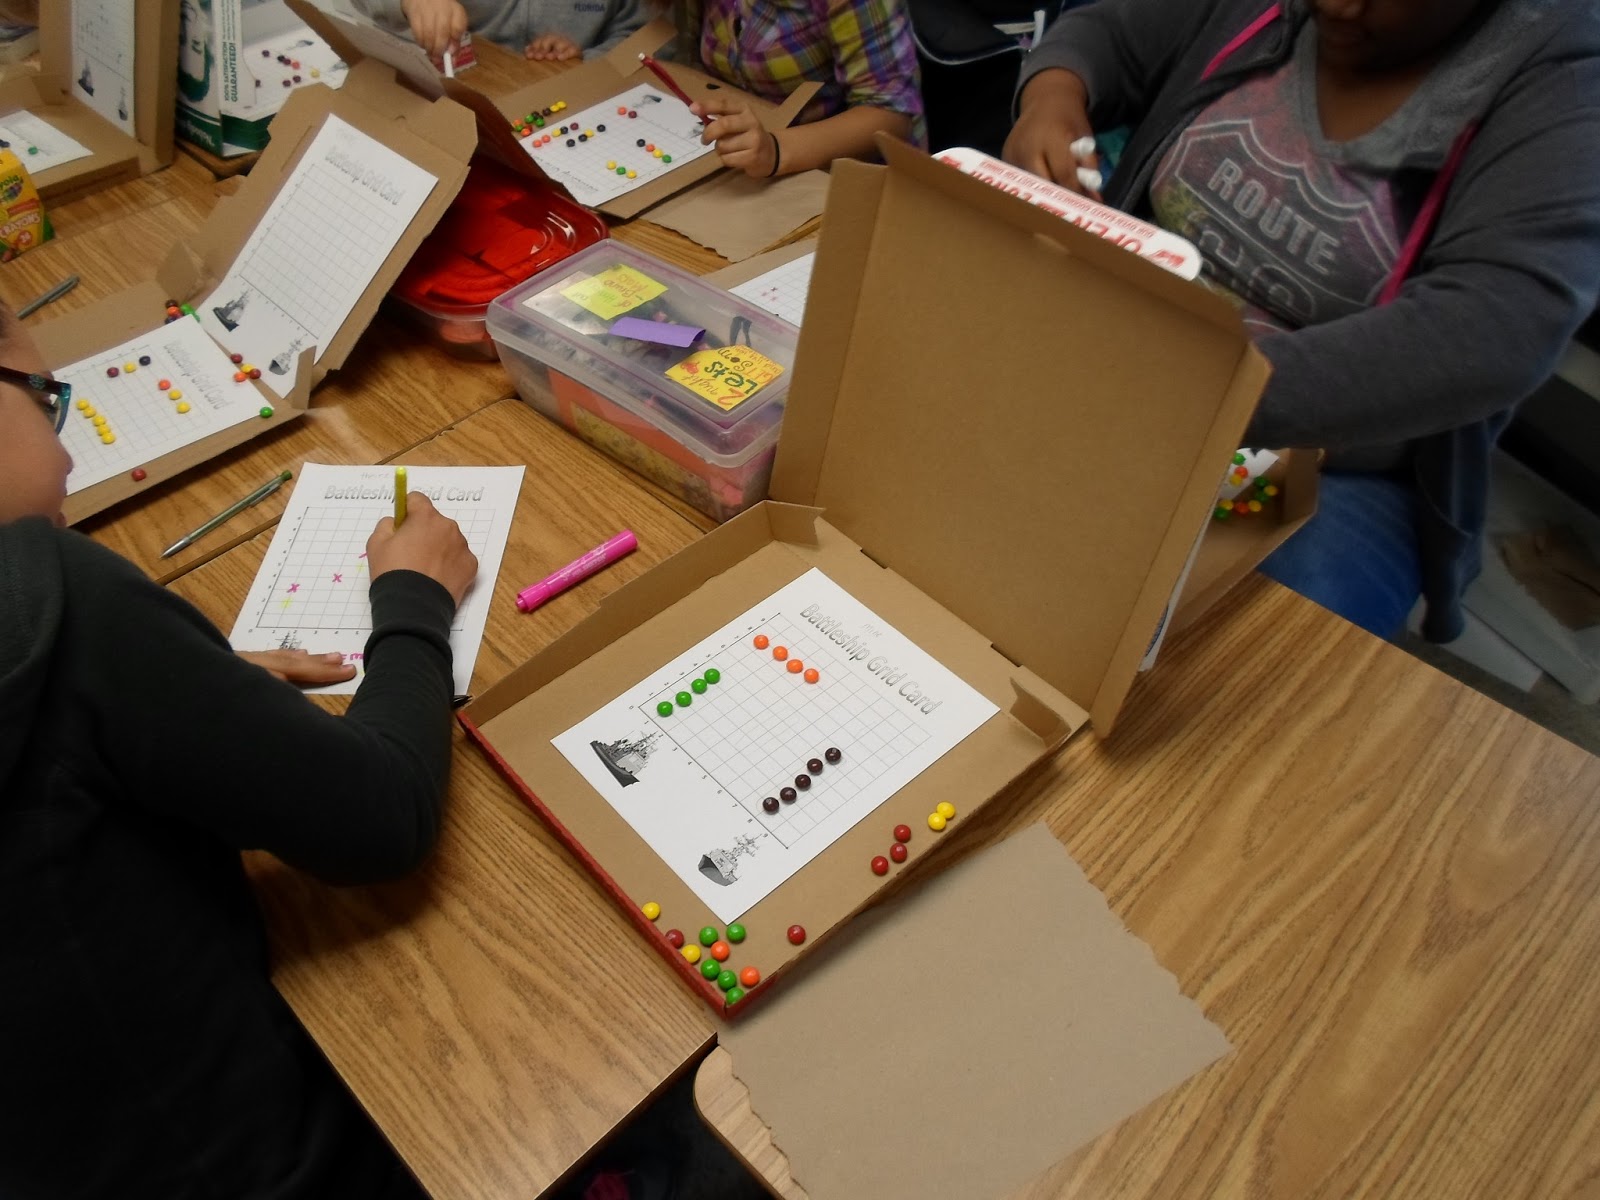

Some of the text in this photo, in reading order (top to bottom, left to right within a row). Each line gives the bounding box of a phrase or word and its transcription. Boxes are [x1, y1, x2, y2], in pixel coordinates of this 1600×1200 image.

[228, 42, 238, 102] GUARANTEED!
[1207, 157, 1341, 276] ROUTE
[704, 361, 758, 395] Lets
[717, 387, 746, 406] 2
[446, 486, 485, 502] Card
[799, 603, 944, 715] Battleship Grid Card
